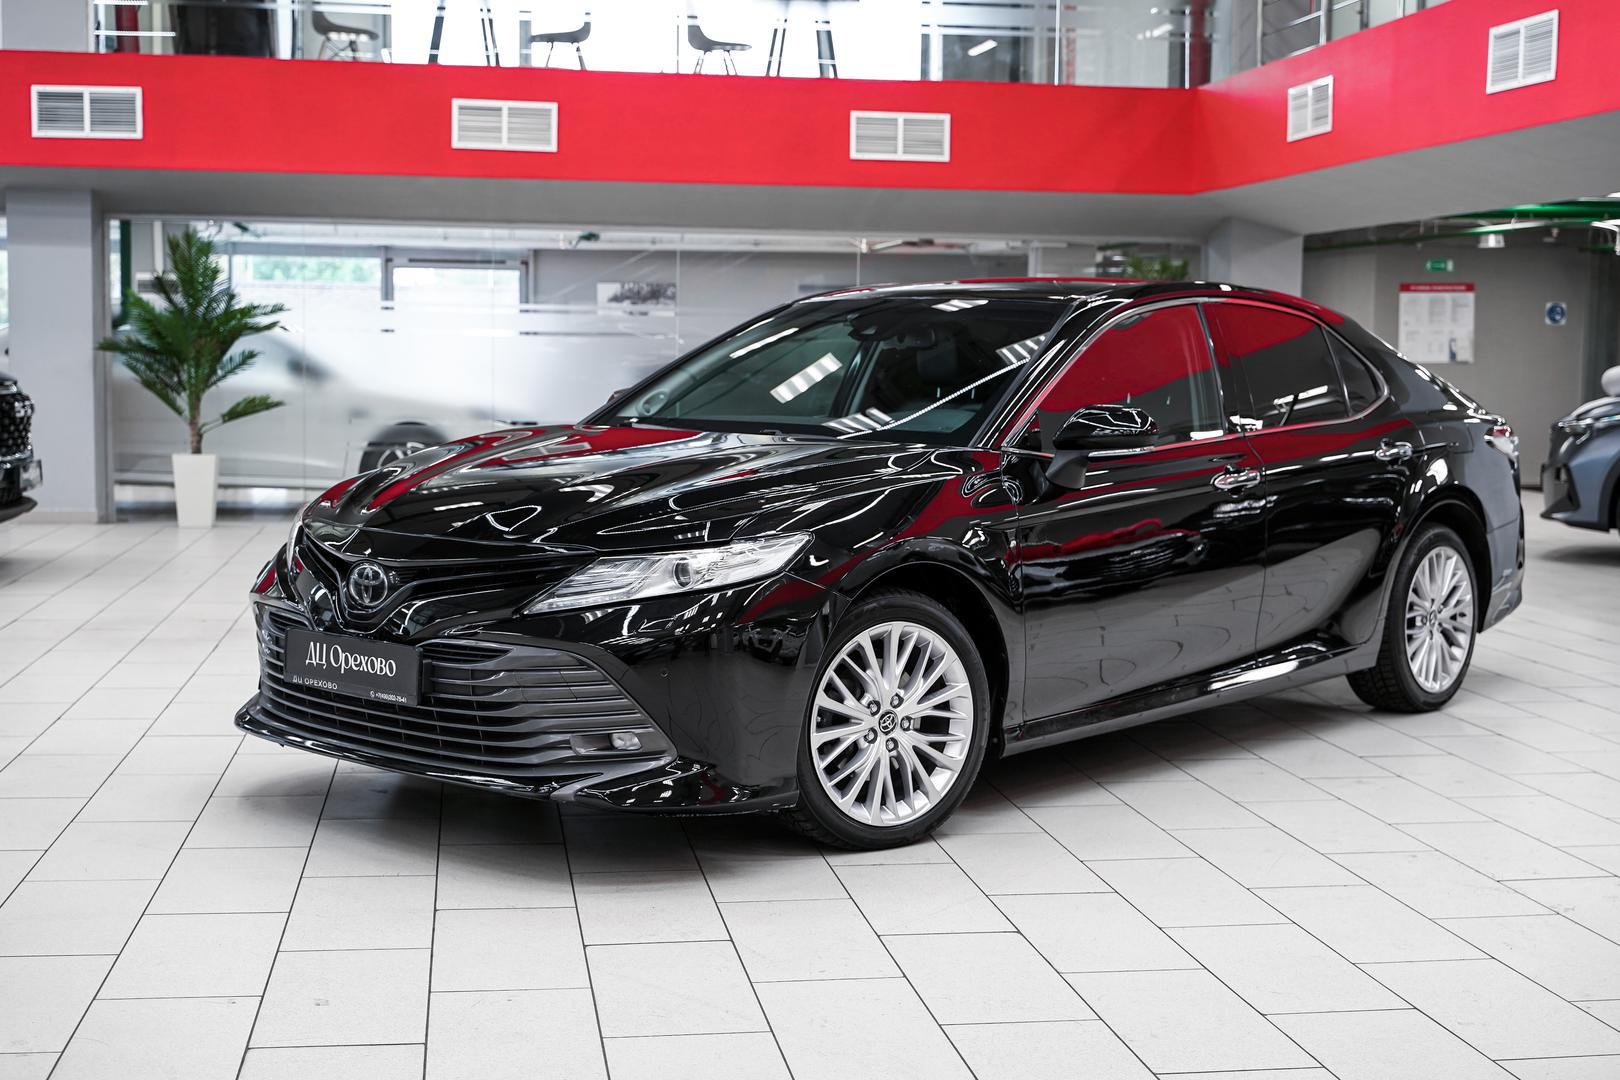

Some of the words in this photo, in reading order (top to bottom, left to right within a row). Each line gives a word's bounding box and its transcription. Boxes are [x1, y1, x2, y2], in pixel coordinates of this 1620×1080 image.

[305, 641, 327, 669] ДЦ
[330, 645, 396, 676] Орехово
[304, 678, 338, 690] ОРЕХОВО
